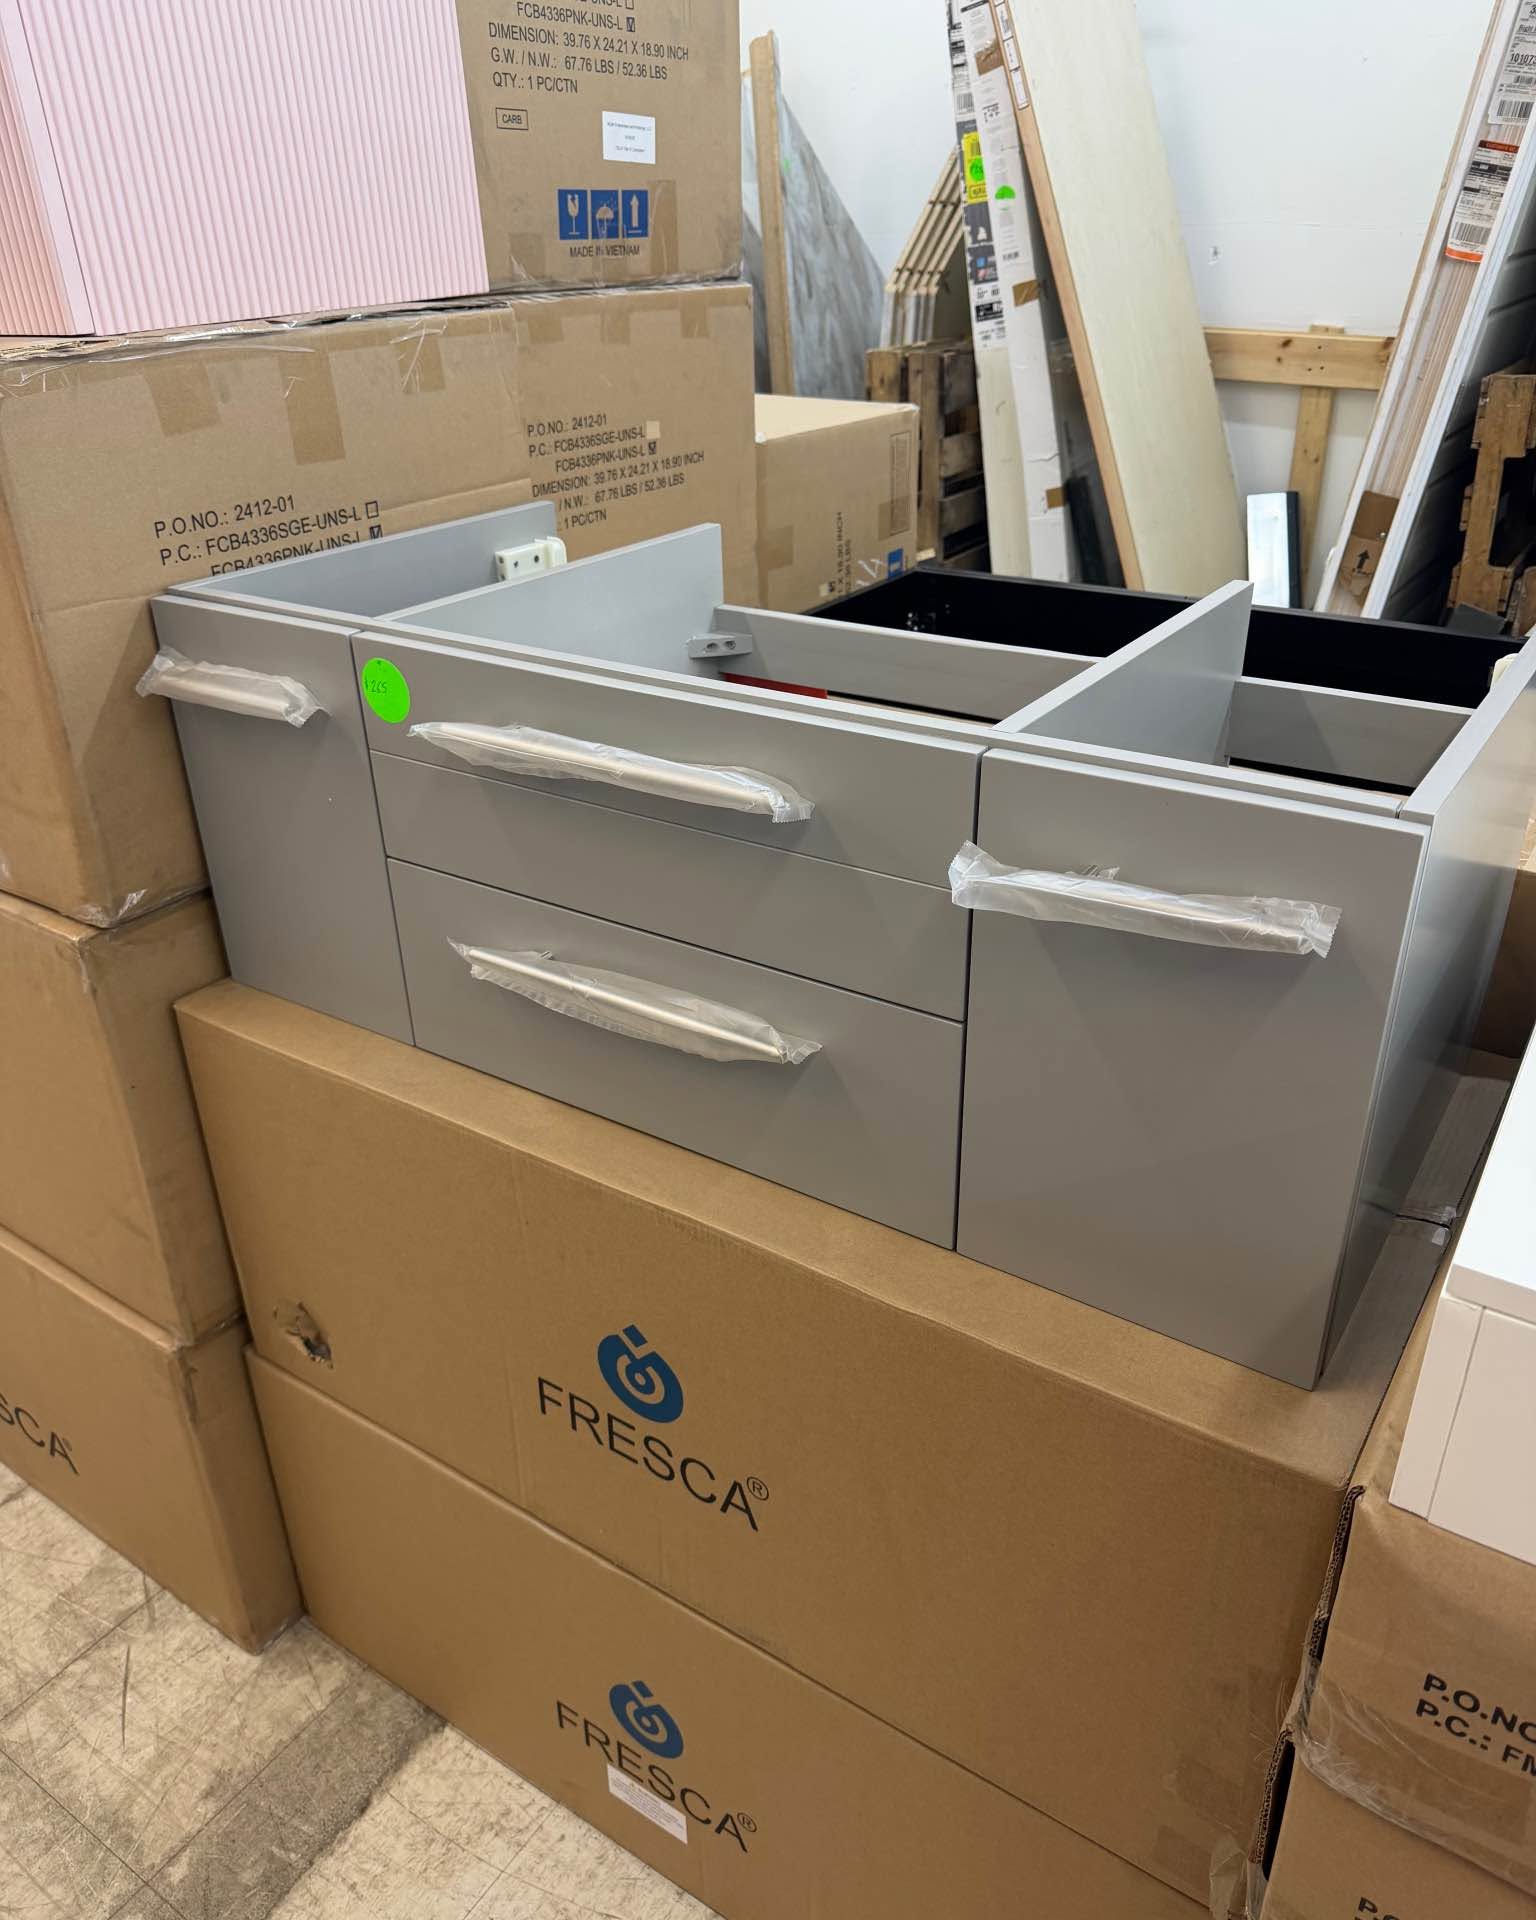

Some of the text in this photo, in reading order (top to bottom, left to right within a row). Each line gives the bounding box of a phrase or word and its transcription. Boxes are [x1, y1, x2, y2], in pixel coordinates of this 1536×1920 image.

[517, 2, 623, 30] FCB4336PNK-UNS-L
[488, 22, 689, 61] DIMENSION: 39.76 X 24.21 X 18.90 INCH
[565, 56, 592, 72] 67.76
[595, 61, 614, 74] LBS
[622, 62, 647, 78] 52.36
[649, 66, 668, 80] LBS
[537, 76, 578, 93] PC/CTN
[502, 113, 522, 125] CARB
[569, 245, 593, 258] MADE
[605, 244, 640, 257] VIETNAM
[572, 413, 607, 431] 2412-01
[554, 424, 646, 454] FCB4336SGE-UNS-L
[555, 443, 645, 473] FCB4336PNK-UNS-L
[532, 474, 590, 498] DIMENSION:
[619, 466, 627, 479] X
[684, 451, 704, 466] INCH
[620, 483, 638, 498] LBS
[668, 472, 685, 487] LBS
[154, 495, 295, 539] P.O.NO.: 2412-01
[572, 509, 607, 528] PC/CTN
[160, 506, 362, 566] P.C.: FCB4336SGE-UNS-L
[1416, 1699, 1491, 1750] P.C.:
